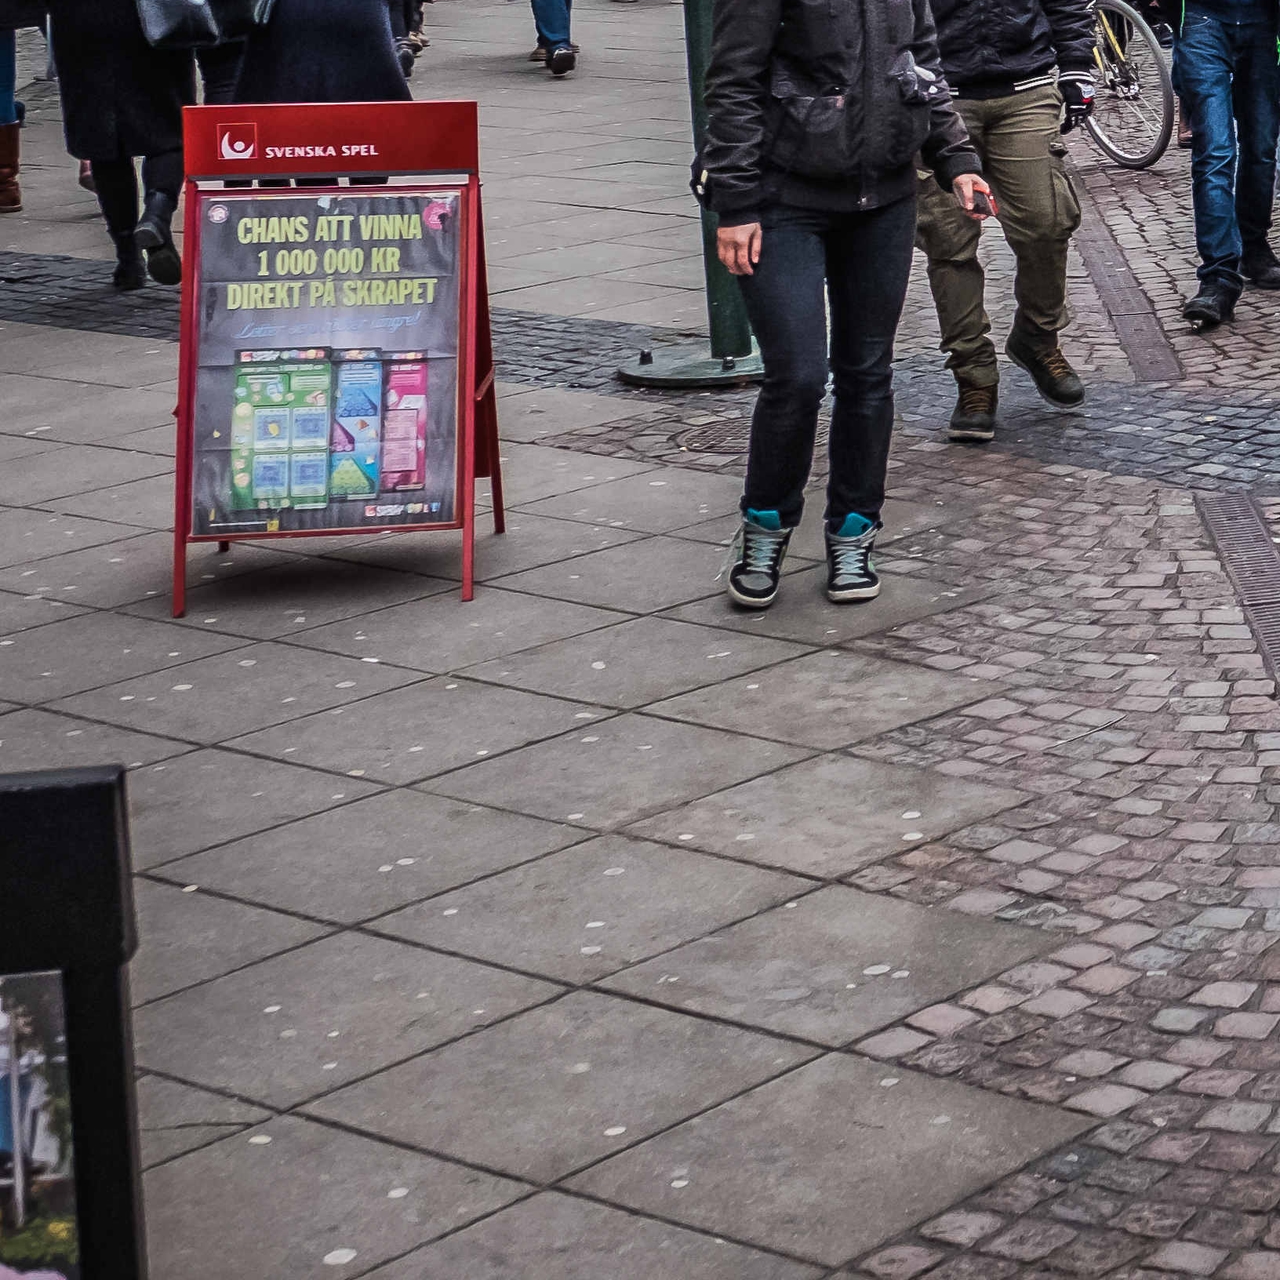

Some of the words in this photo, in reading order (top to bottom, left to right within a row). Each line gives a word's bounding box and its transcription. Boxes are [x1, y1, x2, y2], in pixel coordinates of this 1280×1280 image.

[265, 145, 337, 158] SVENSKA
[341, 144, 379, 156] SPEL
[237, 216, 309, 244] CHANS
[314, 215, 354, 241] ATT
[359, 214, 423, 240] VINNA
[257, 250, 270, 276] 1
[275, 249, 319, 275] 000
[323, 248, 364, 274] 000
[370, 247, 401, 273] KR
[226, 282, 304, 310] DIREKT
[309, 277, 337, 307] PÅ
[342, 278, 438, 305] SKRAPET
